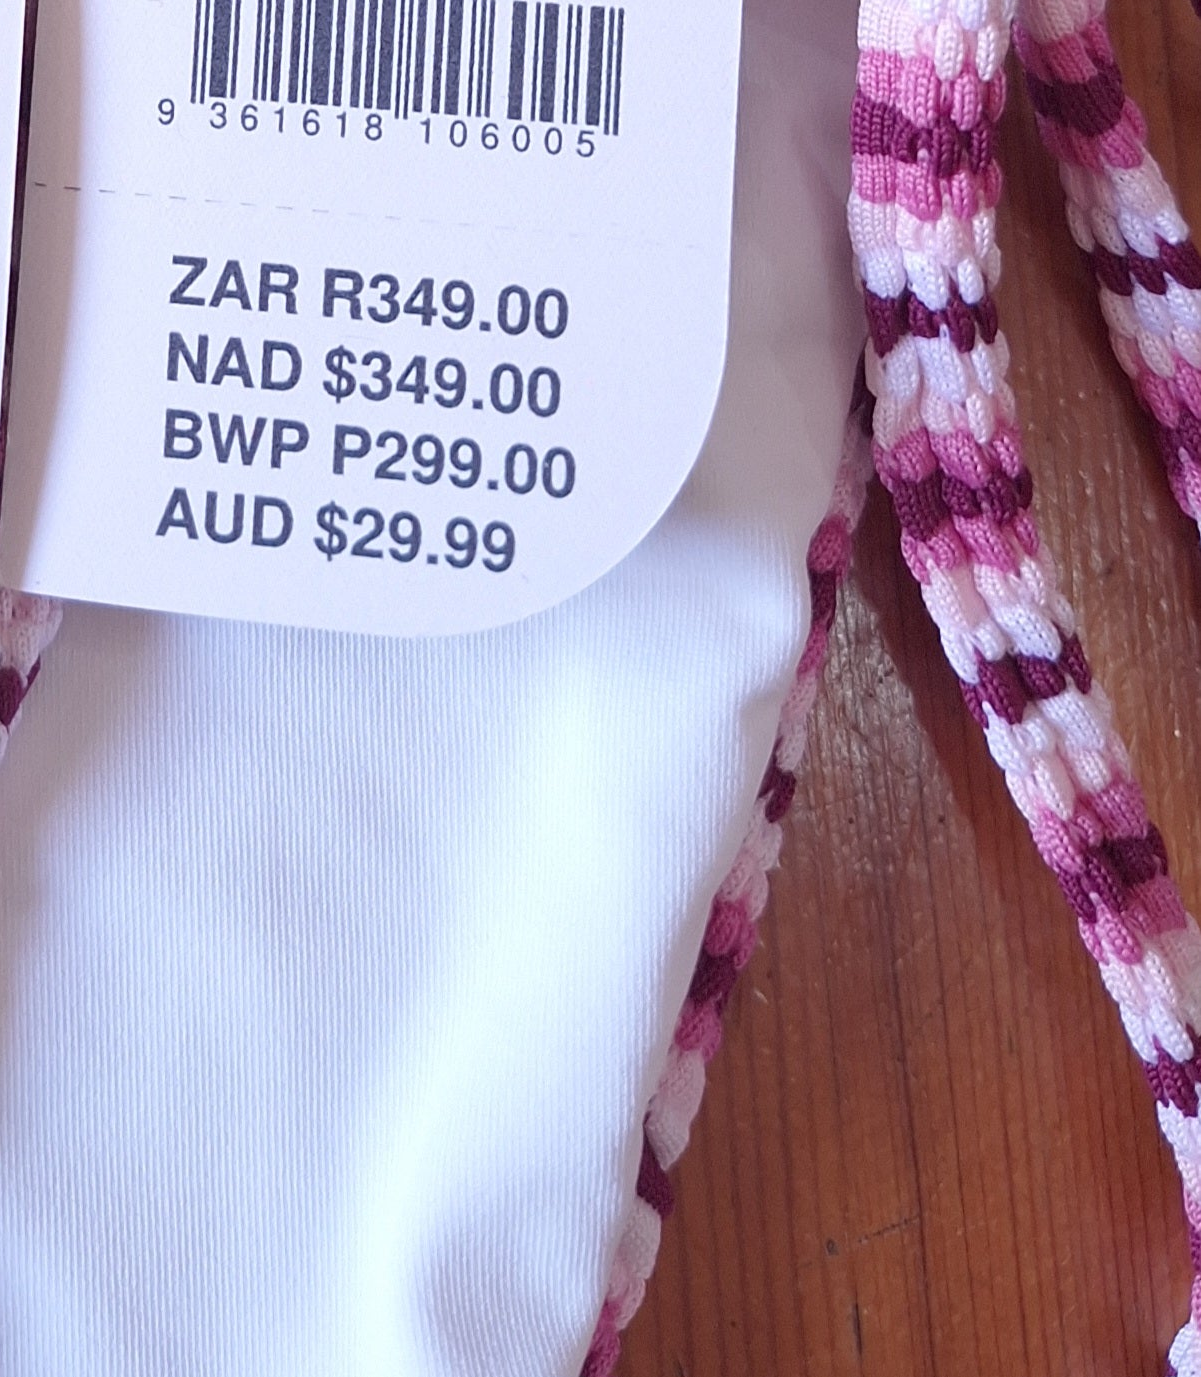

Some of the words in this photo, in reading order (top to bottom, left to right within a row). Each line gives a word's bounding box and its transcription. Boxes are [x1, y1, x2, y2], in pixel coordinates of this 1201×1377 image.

[170, 256, 298, 314] ZAR
[323, 268, 568, 339] R349.00
[167, 332, 302, 391] NAD
[323, 346, 560, 417] $349.00
[164, 409, 309, 469] BWP
[332, 425, 575, 502] P299.00
[156, 488, 293, 547] AUD
[314, 501, 515, 572] $29.99
